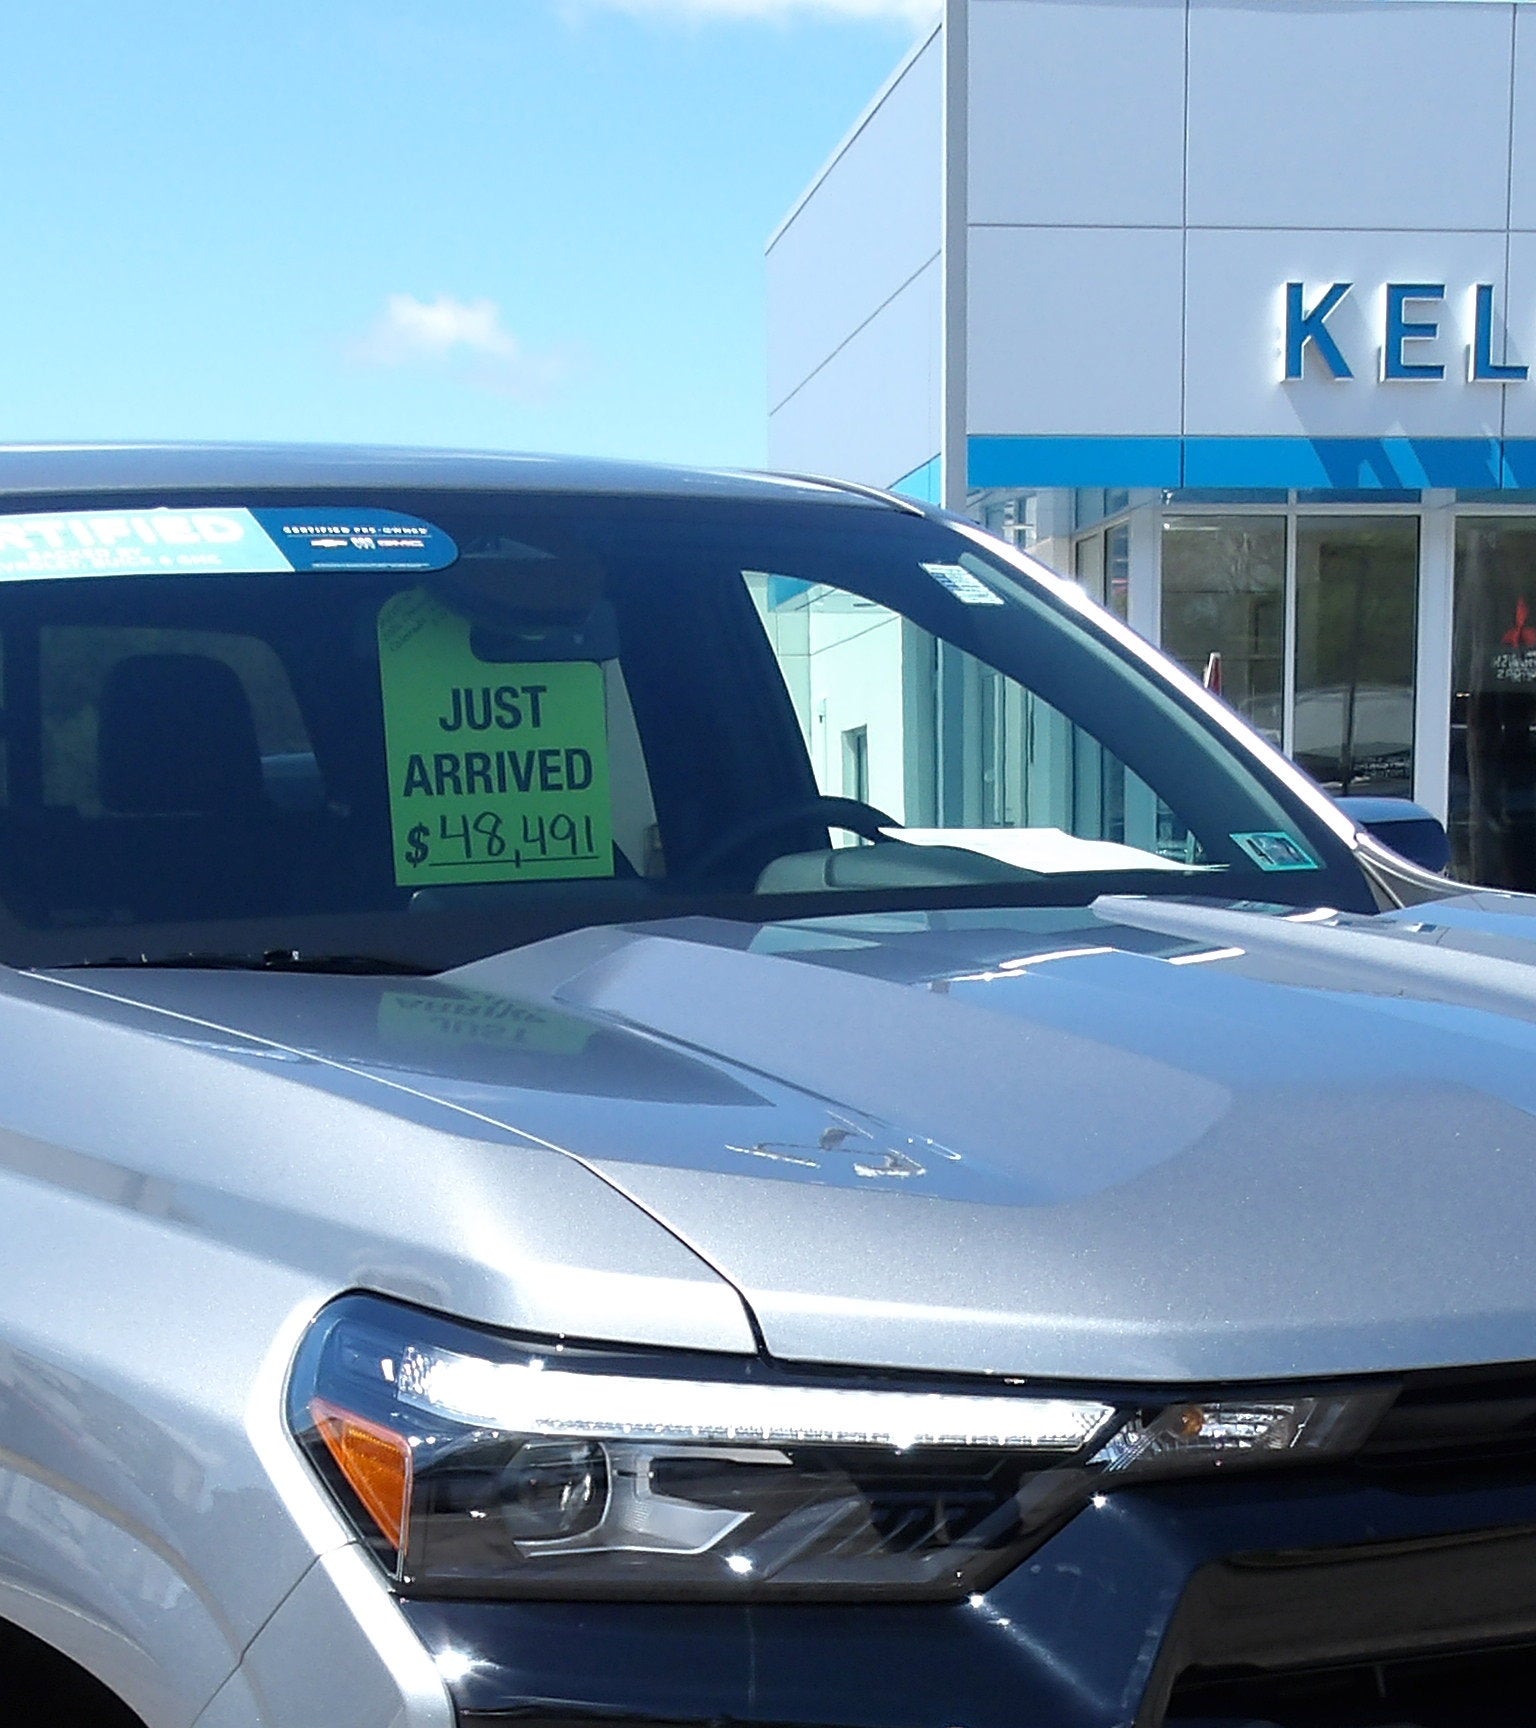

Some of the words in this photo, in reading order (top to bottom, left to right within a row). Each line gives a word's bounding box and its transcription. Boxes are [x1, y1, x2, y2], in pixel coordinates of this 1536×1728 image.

[439, 686, 548, 733] JUST
[403, 747, 593, 797] ARRIVED
[404, 811, 598, 868] $48,491
